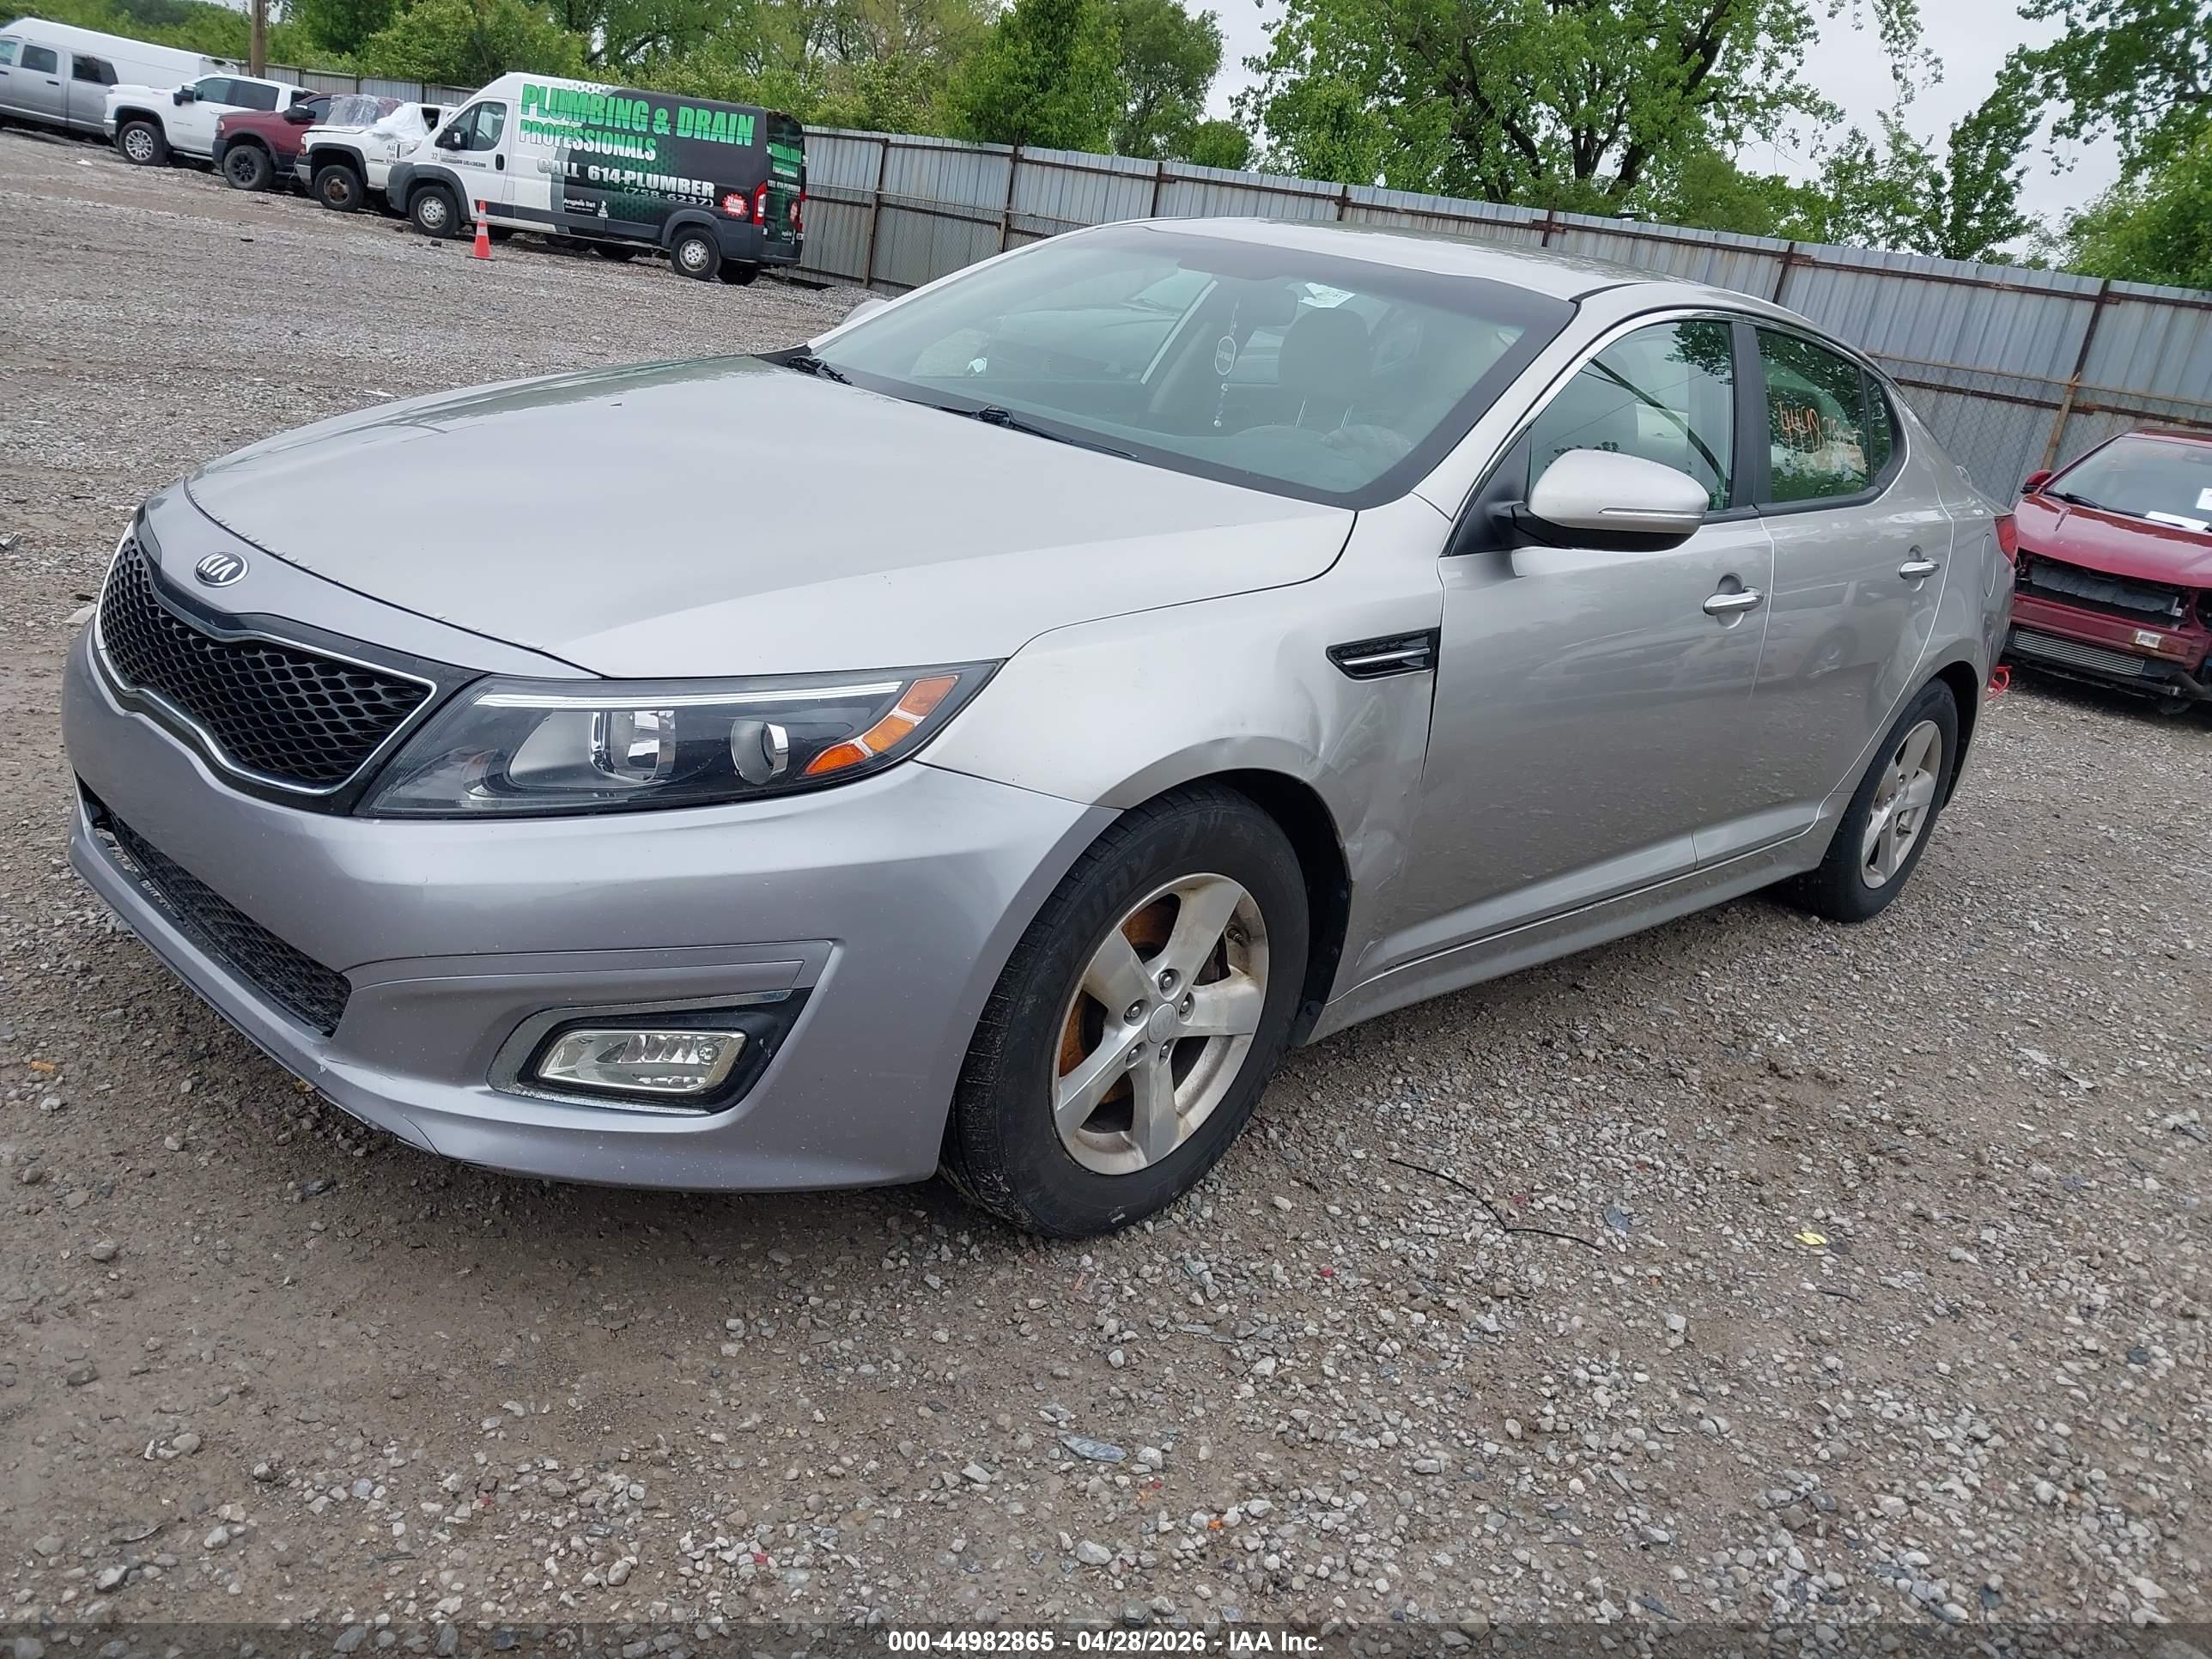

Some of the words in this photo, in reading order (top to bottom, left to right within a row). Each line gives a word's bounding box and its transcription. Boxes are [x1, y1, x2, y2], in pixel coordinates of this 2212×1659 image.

[521, 83, 650, 133] PLUMBING
[653, 108, 672, 136] &
[676, 106, 756, 147] DRAIN
[520, 118, 657, 161] PROFESSIONALS
[538, 158, 580, 179] CALL
[587, 165, 715, 198] 614-PLUMBER
[623, 185, 715, 208] (758-6237)
[198, 552, 239, 581] KIA
